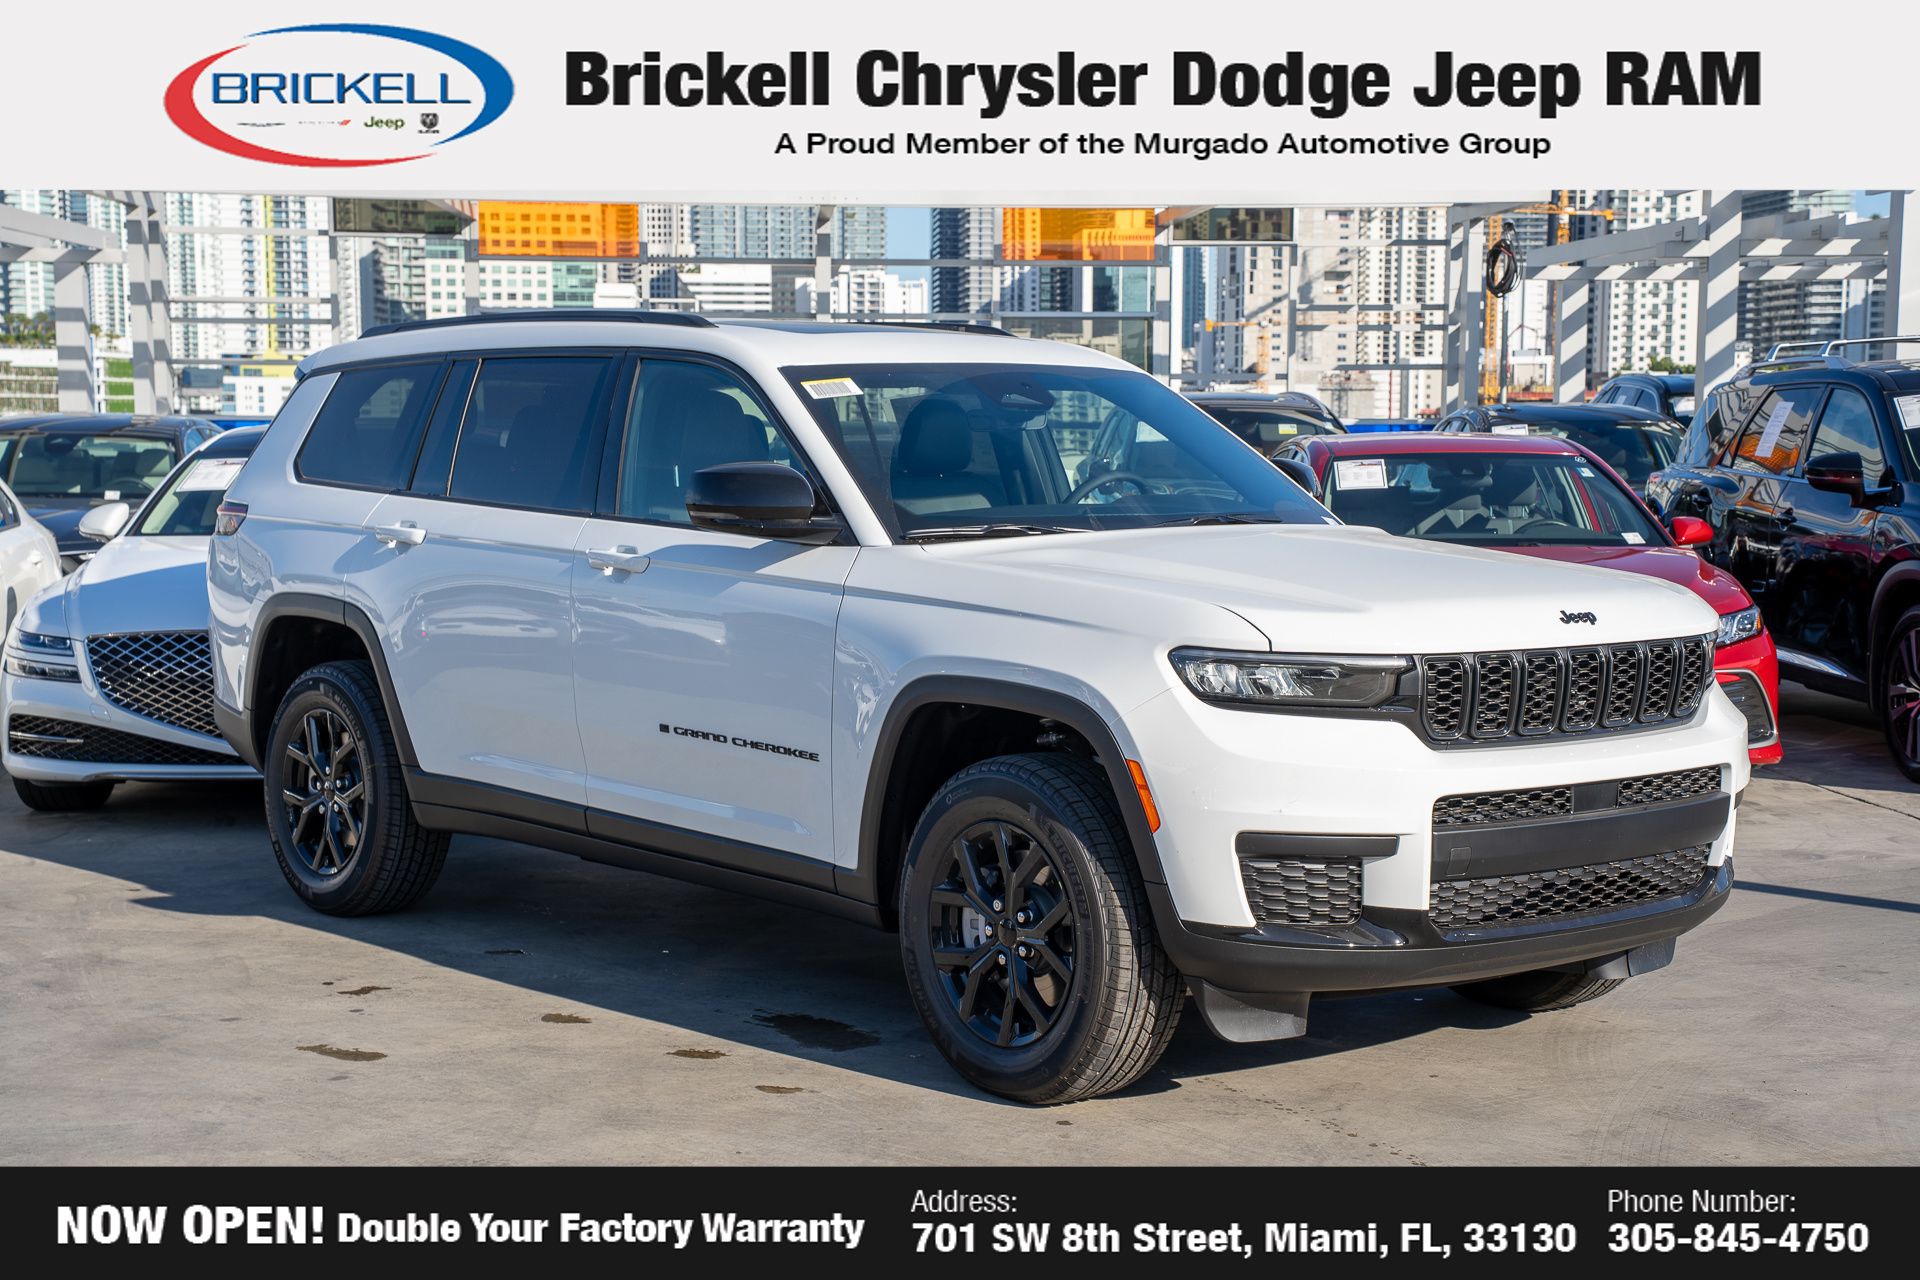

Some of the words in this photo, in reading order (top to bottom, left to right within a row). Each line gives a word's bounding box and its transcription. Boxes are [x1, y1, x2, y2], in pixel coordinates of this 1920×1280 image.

[1559, 610, 1597, 625] Jeep
[673, 726, 728, 744] GRAND
[731, 737, 820, 762] CHEROKEE
